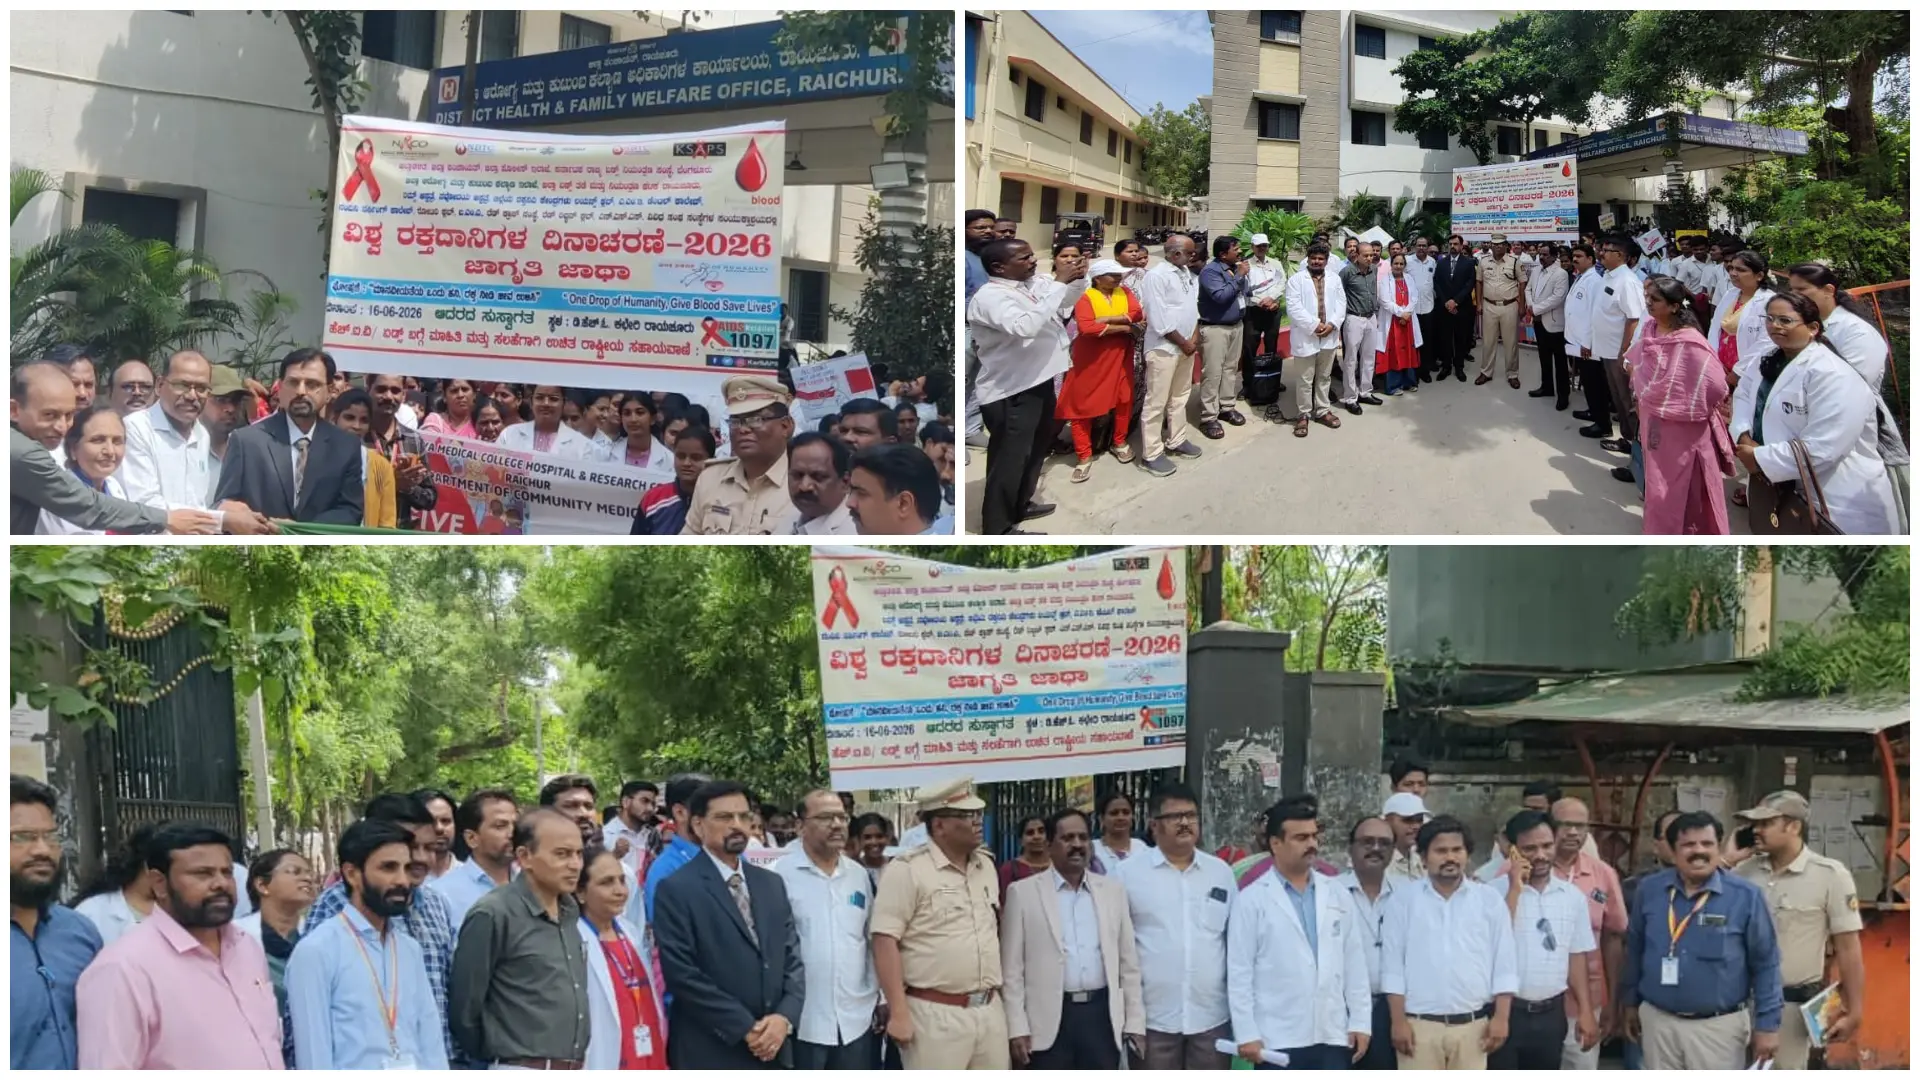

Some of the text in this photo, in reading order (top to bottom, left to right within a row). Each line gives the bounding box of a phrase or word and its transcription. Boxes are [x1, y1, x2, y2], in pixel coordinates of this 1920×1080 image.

[435, 106, 492, 125] DISTICT
[495, 100, 550, 120] HEALTH
[554, 100, 566, 115] &
[570, 93, 625, 113] FAMILY
[631, 84, 713, 108] WELFARE
[717, 78, 792, 99] OFFICE,
[482, 80, 518, 105] ಆರೋಗ್ಯ
[522, 79, 544, 100] ಮತ್ತು
[549, 76, 587, 93] ಕುಟುಂಬ
[589, 74, 622, 95] ಕಲ್ಯಾಣ
[675, 143, 726, 157] KSAPS
[750, 195, 781, 205] blood
[343, 221, 383, 256] ವಿಶ್ವ
[397, 221, 528, 256] ರಕ್ತದಾನಿಗಳ
[464, 256, 631, 285] ಜಾಗೃತಿ ಜಾಥಾ
[369, 305, 422, 319] 16-06-2026
[588, 294, 610, 308] Drop
[612, 294, 622, 306] of
[623, 295, 669, 310] Humanity,
[670, 298, 692, 310] Give
[693, 299, 721, 311] Blood
[722, 300, 746, 312] Save
[435, 306, 535, 330] ಆದರದ ಸುಸ್ವಾಗತ
[644, 320, 695, 333] ರಾಯಚೂರು
[408, 327, 426, 347] ಬಗ್ಗೆ
[429, 329, 463, 343] ಮಾಹಿತಿ
[466, 332, 489, 348] ಮತ್ತು
[493, 332, 542, 348] ಸಲಹೆಗಾಗಿ
[546, 337, 577, 349] ಉಚಿತ
[581, 338, 624, 360] ರಾಷ್ಟ್ರೀಯ
[628, 341, 691, 356] ಸಹಾಯವಾಣಿ
[730, 332, 774, 350] 1097
[437, 443, 479, 461] MEDICAL
[480, 452, 524, 470] COLLEGE
[525, 461, 576, 480] HOSPITAL
[578, 471, 587, 481] &
[589, 471, 647, 491] RESEARCH
[504, 473, 551, 491] RAICHUR
[427, 472, 642, 519] PARTMENT OF COMMUNITY MEDIC
[411, 509, 465, 535] IVE
[830, 646, 868, 680] ವಿಶ್ವ
[880, 643, 1003, 675] ರಕ್ತದಾನಿಗಳ
[948, 670, 1089, 695] ಜಾಗೃತಿ ಜಾಥಾ
